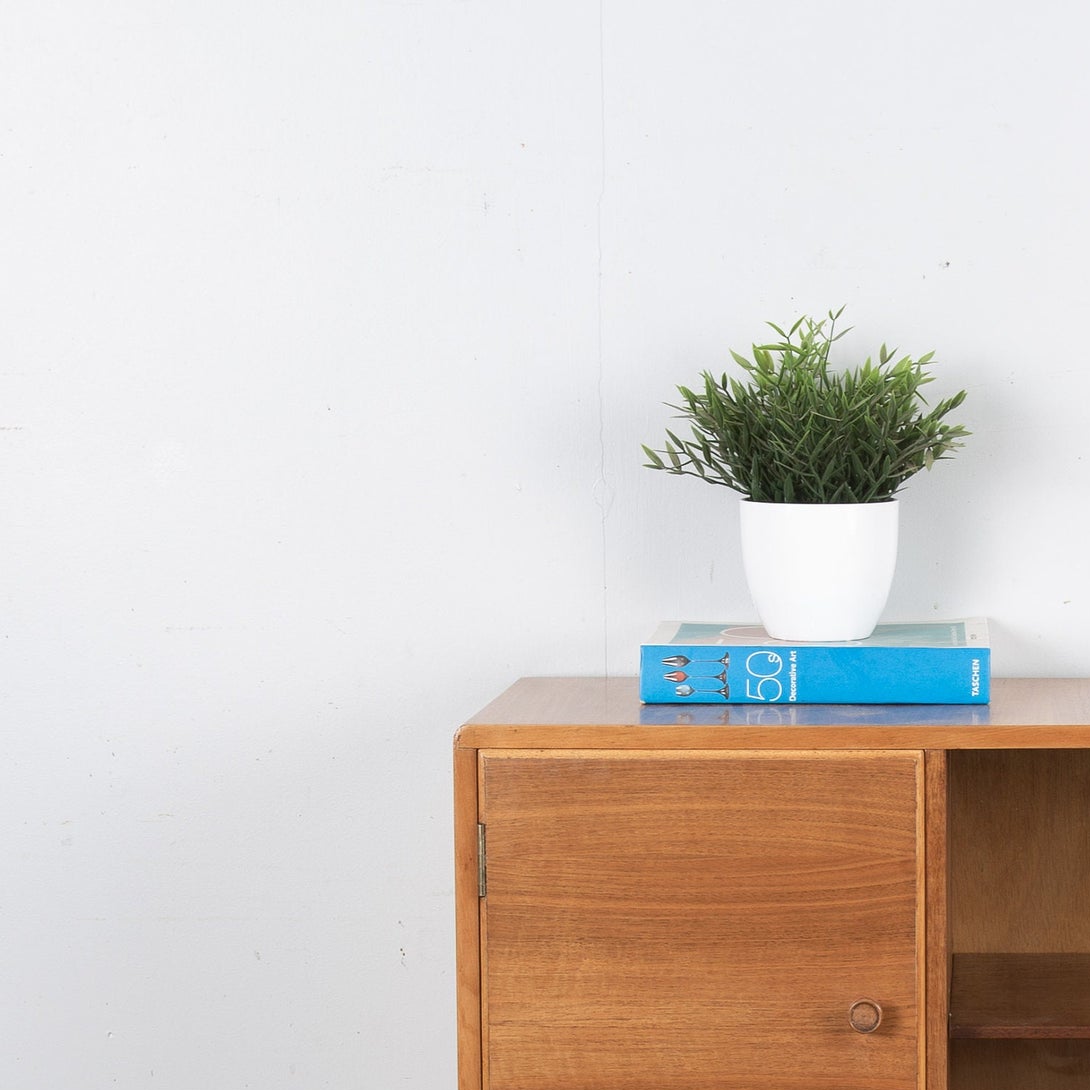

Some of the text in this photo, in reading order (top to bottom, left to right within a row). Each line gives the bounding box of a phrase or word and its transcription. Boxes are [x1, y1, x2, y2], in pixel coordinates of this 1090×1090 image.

[746, 651, 782, 701] 50s
[789, 651, 797, 701] Decorative Art
[971, 659, 980, 696] TASCHEN
